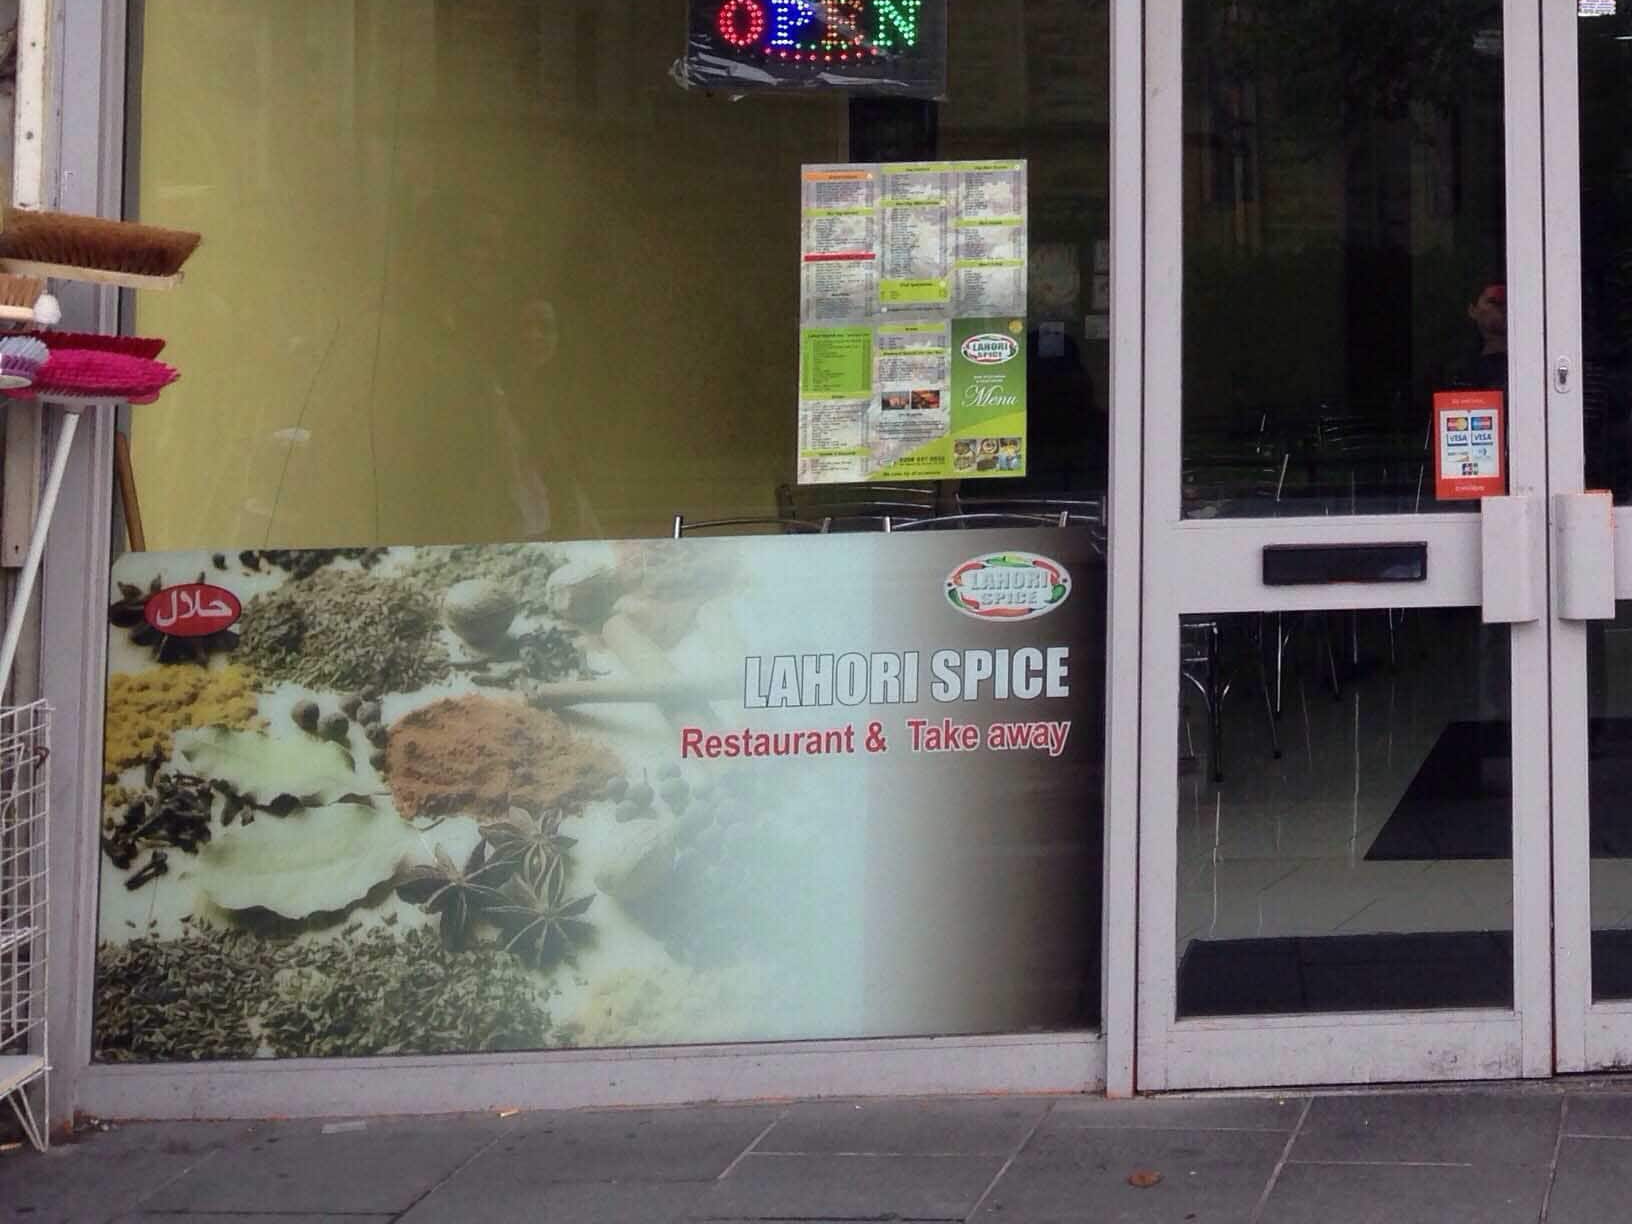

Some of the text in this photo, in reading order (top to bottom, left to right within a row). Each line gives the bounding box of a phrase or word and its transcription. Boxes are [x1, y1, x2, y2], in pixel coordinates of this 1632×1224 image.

[961, 384, 1017, 407] Menu
[970, 569, 1048, 590] LAHORI
[981, 591, 1039, 605] SPICE
[744, 647, 1070, 708] LAHORI SPICE
[680, 718, 1071, 759] Restaurant & Take away
